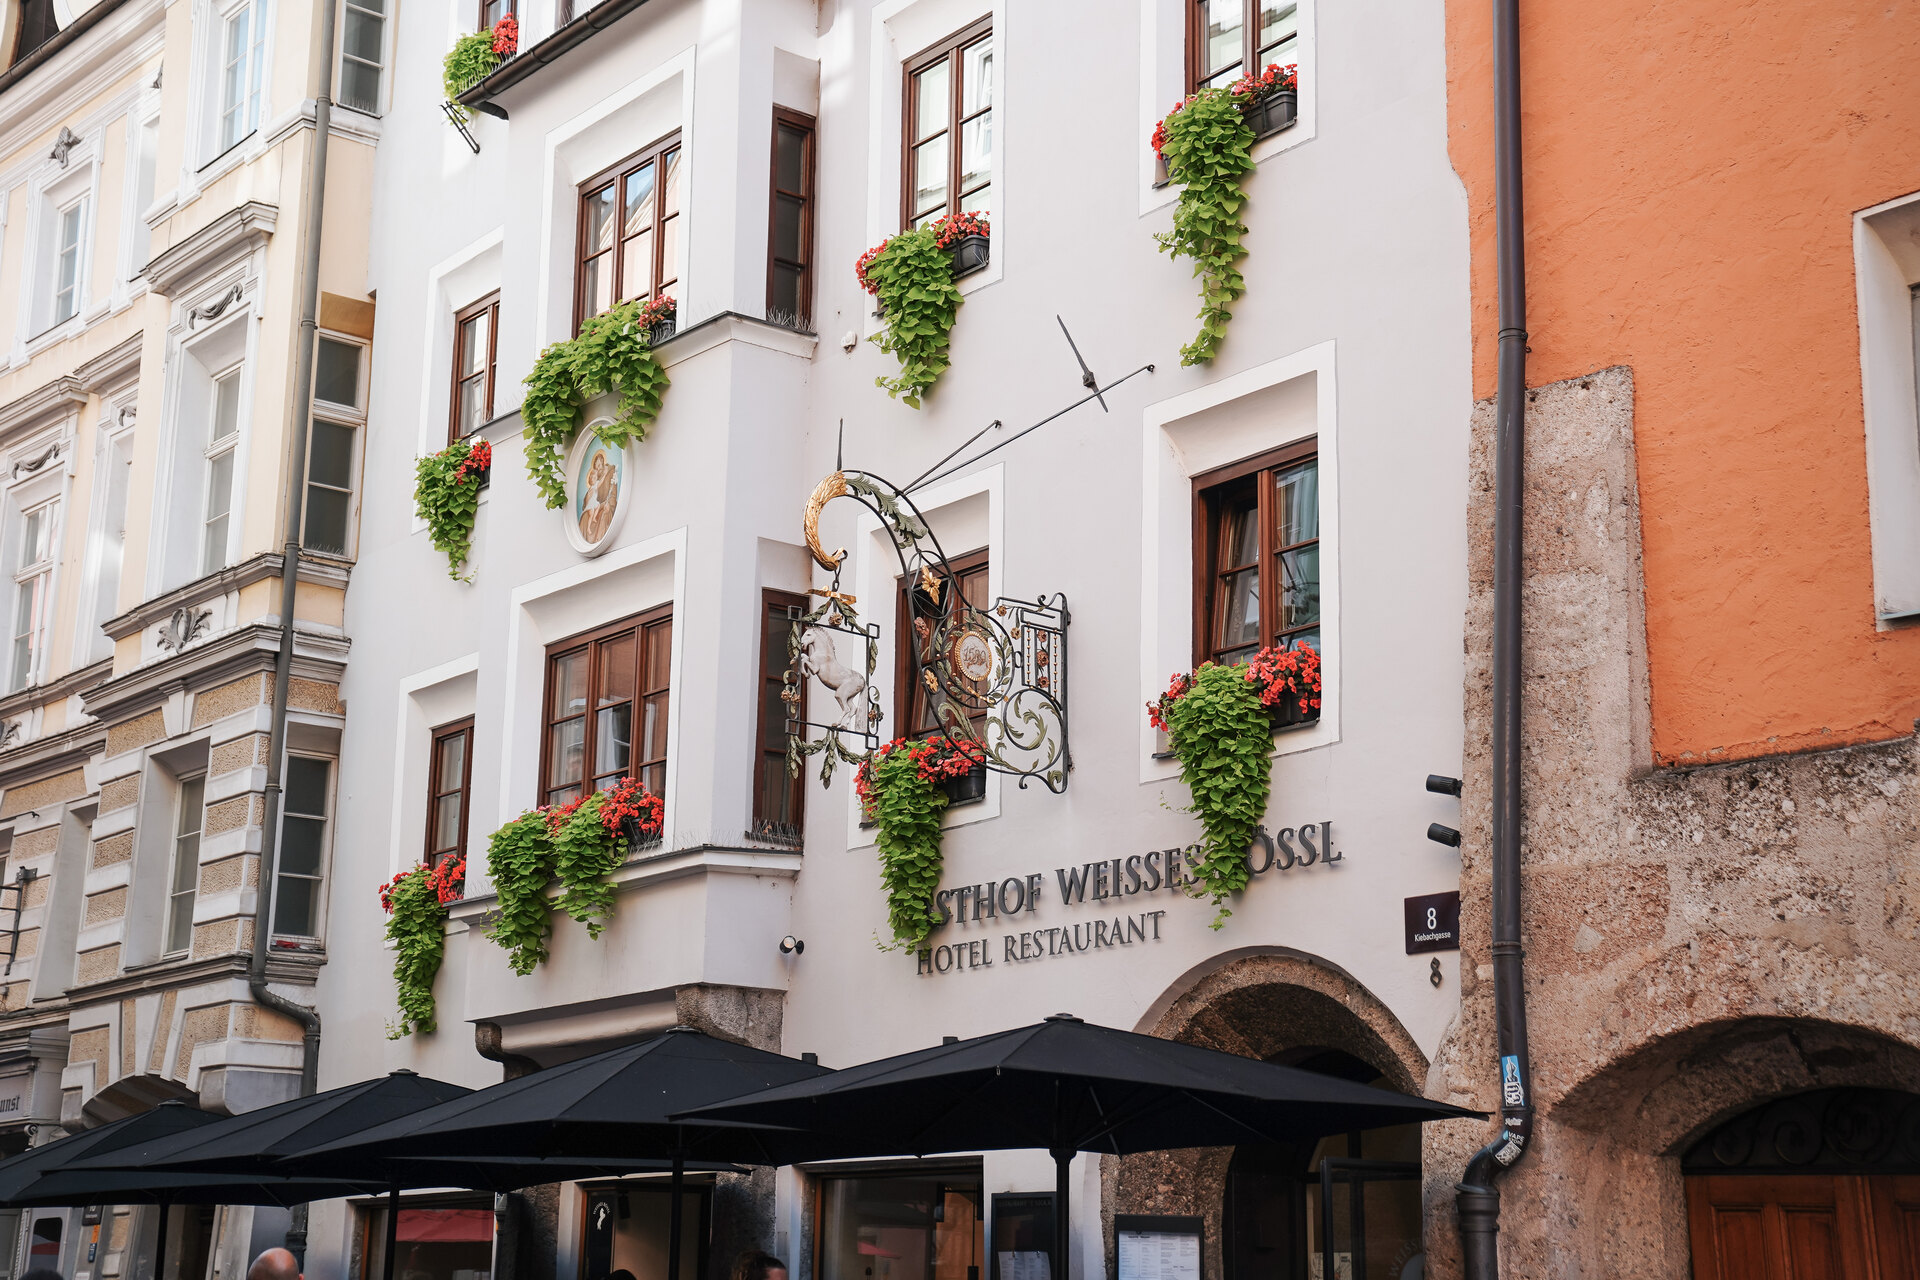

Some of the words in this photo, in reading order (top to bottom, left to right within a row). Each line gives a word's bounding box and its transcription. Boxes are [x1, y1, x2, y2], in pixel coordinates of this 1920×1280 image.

[1055, 844, 1204, 905] WEISSES
[1246, 820, 1343, 875] ÖSSL
[1414, 931, 1451, 942] Kiebachgasse
[1426, 907, 1437, 930] 8
[916, 939, 993, 976] HOTEL
[1003, 910, 1166, 963] RESTAURANT
